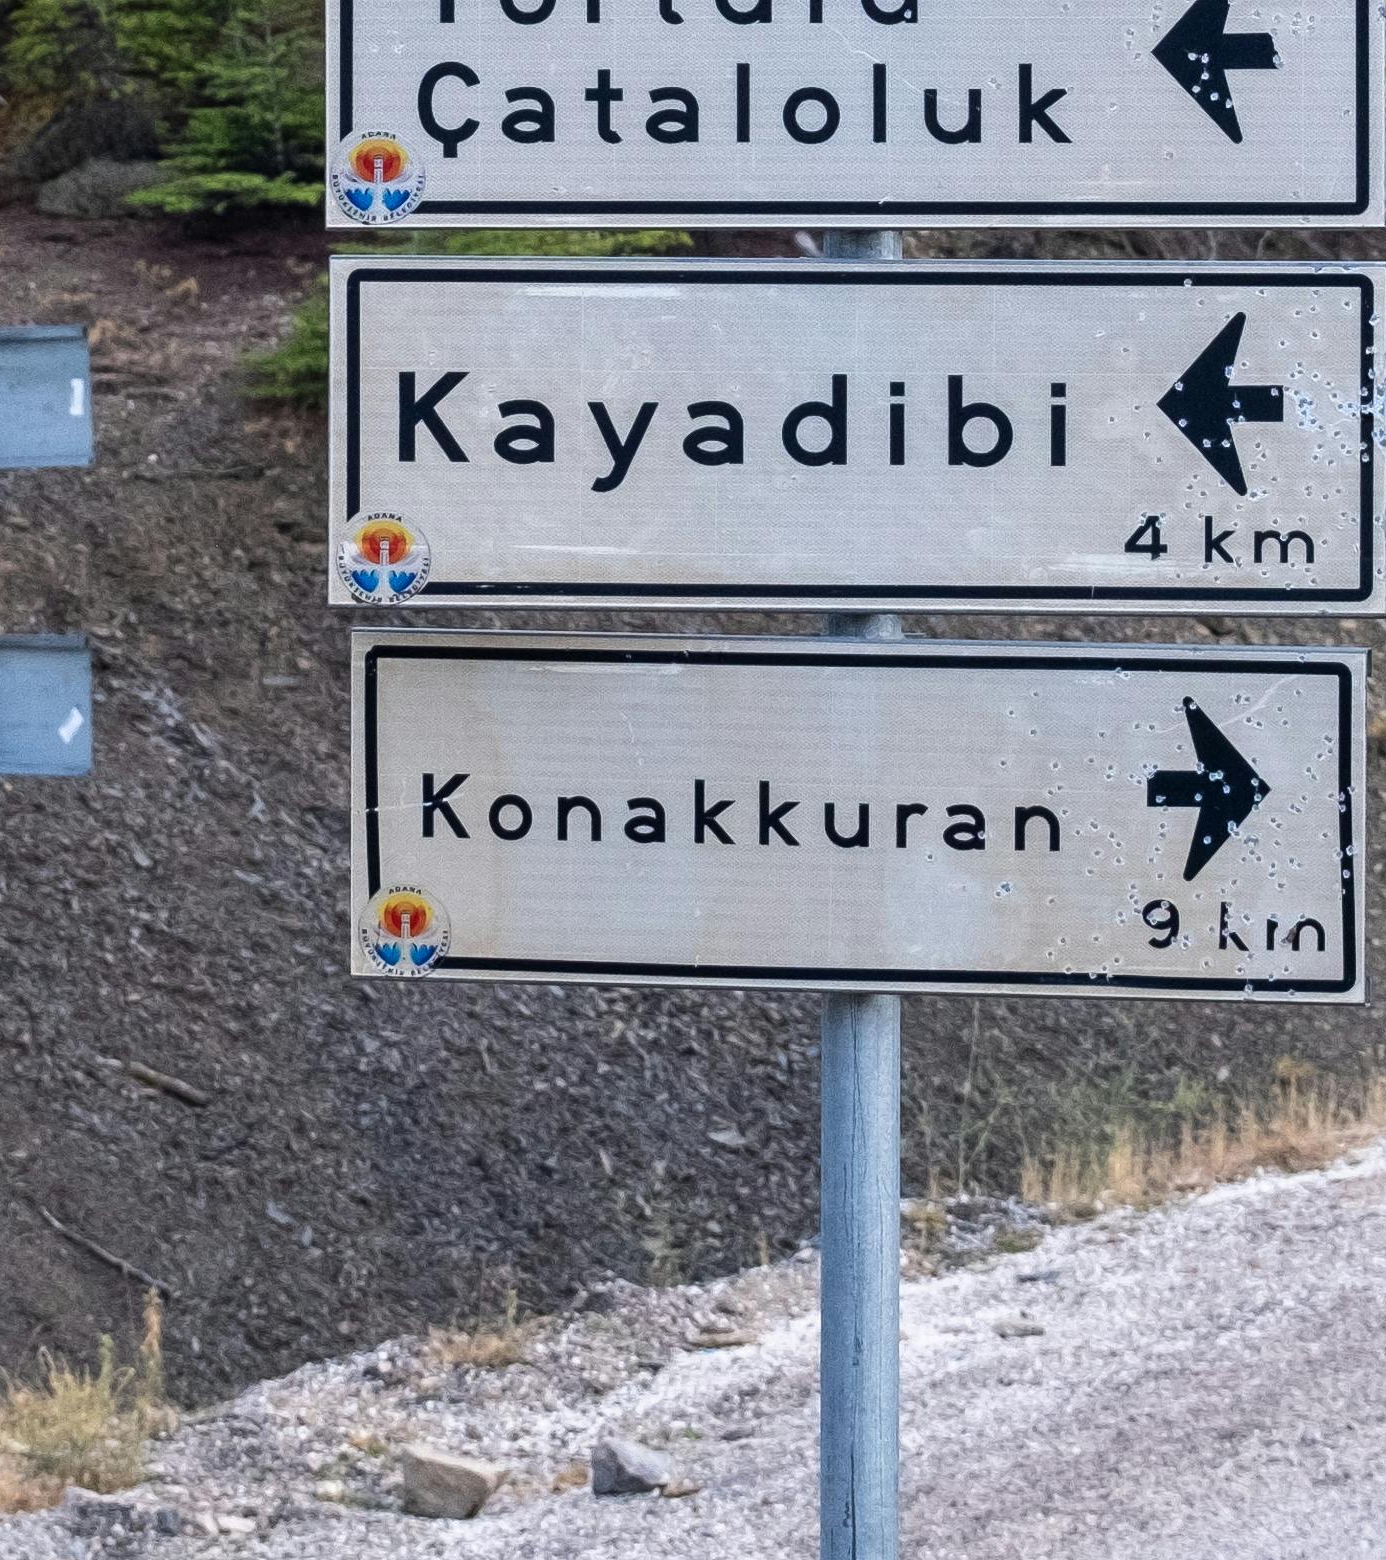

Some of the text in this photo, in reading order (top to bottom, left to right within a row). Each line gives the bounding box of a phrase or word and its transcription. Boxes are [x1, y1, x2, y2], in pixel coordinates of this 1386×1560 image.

[417, 62, 1073, 159] Çataloluk
[397, 370, 1068, 493] Kayadibi
[1124, 515, 1316, 565] 4 km
[421, 772, 1061, 852] Konakkuran
[1141, 899, 1326, 952] 9 km
